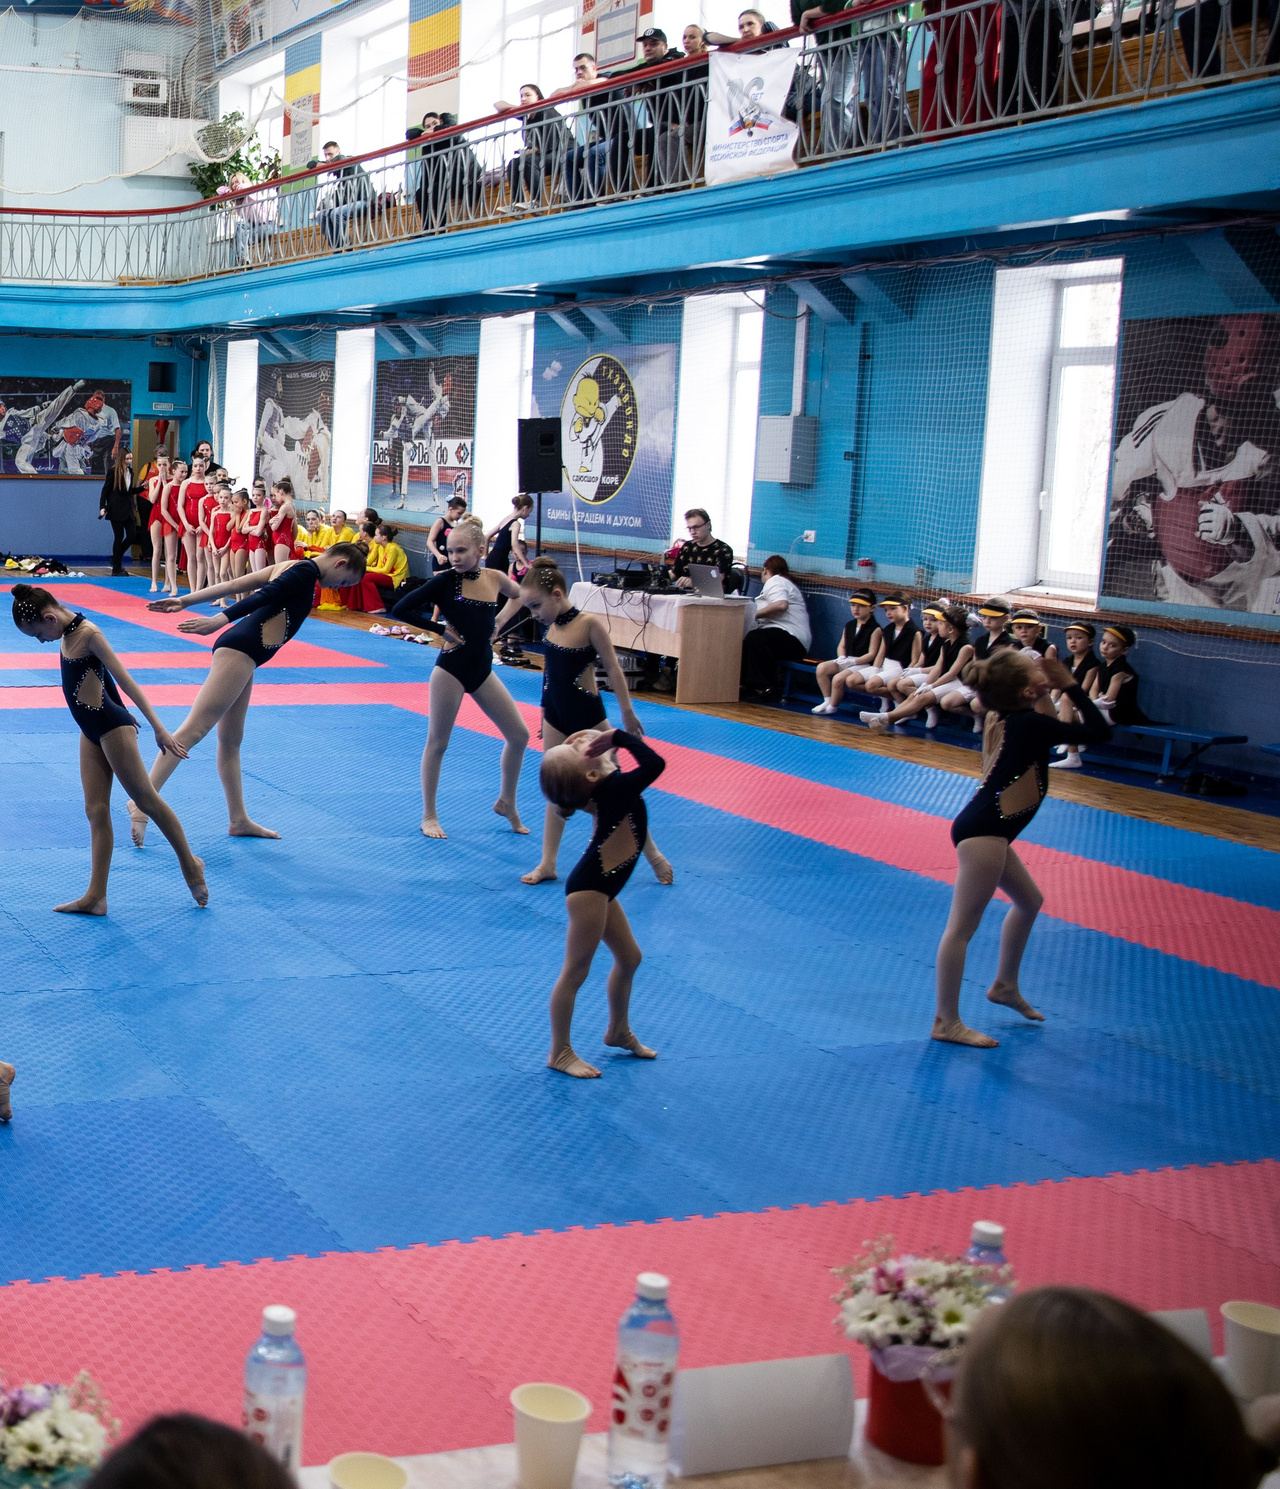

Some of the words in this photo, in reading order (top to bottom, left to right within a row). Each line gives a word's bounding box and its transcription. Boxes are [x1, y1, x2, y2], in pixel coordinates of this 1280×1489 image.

[418, 442, 448, 464] Dado
[547, 508, 570, 521] ЕДИНЫ
[606, 514, 612, 525] И
[612, 515, 642, 528] ДУХОМ
